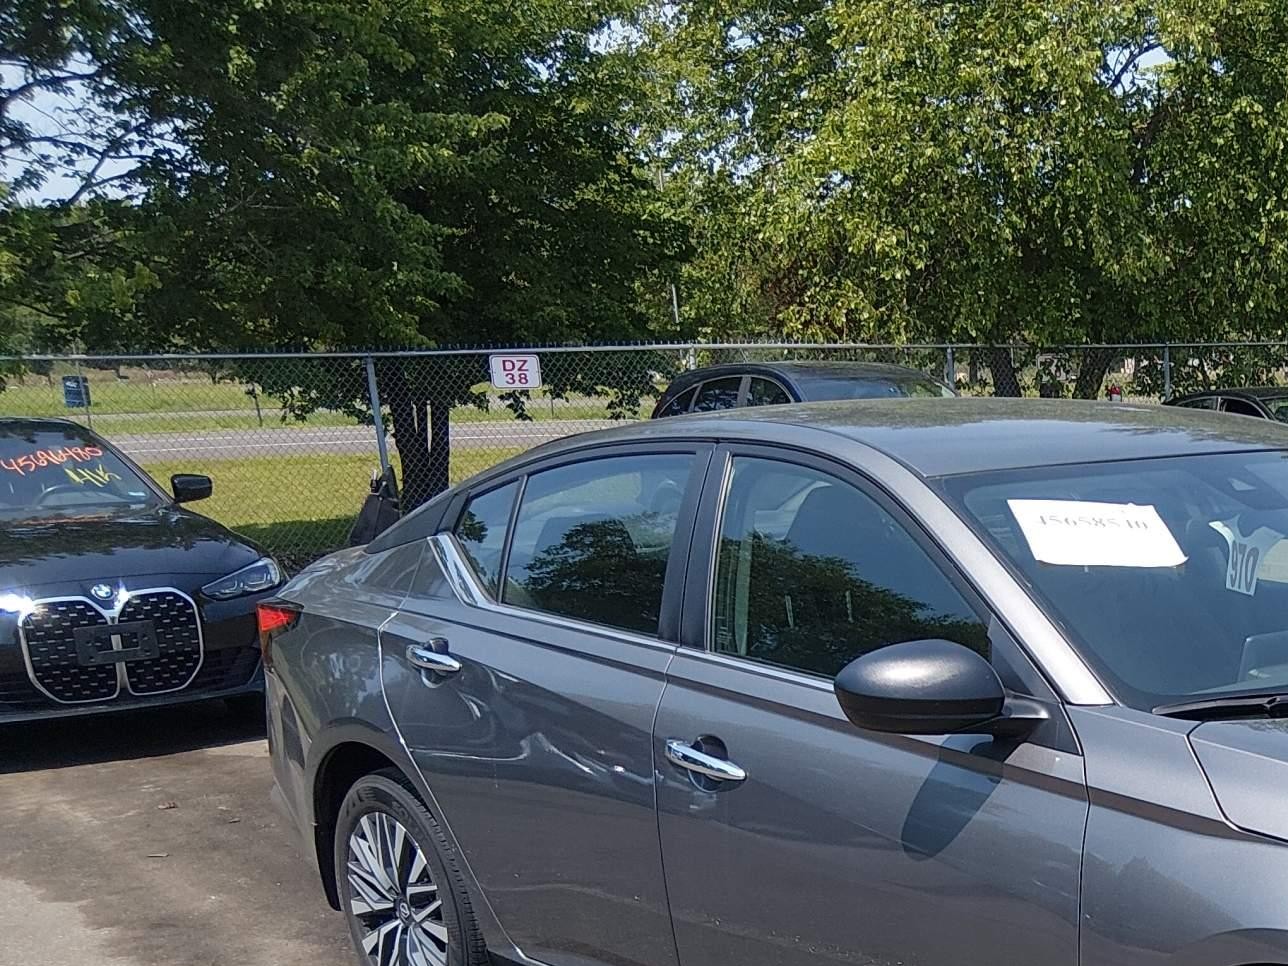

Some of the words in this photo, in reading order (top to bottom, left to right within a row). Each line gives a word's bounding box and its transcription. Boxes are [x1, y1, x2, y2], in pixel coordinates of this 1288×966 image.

[501, 359, 529, 372] DZ
[505, 372, 529, 385] 38
[1229, 540, 1260, 593] 970
